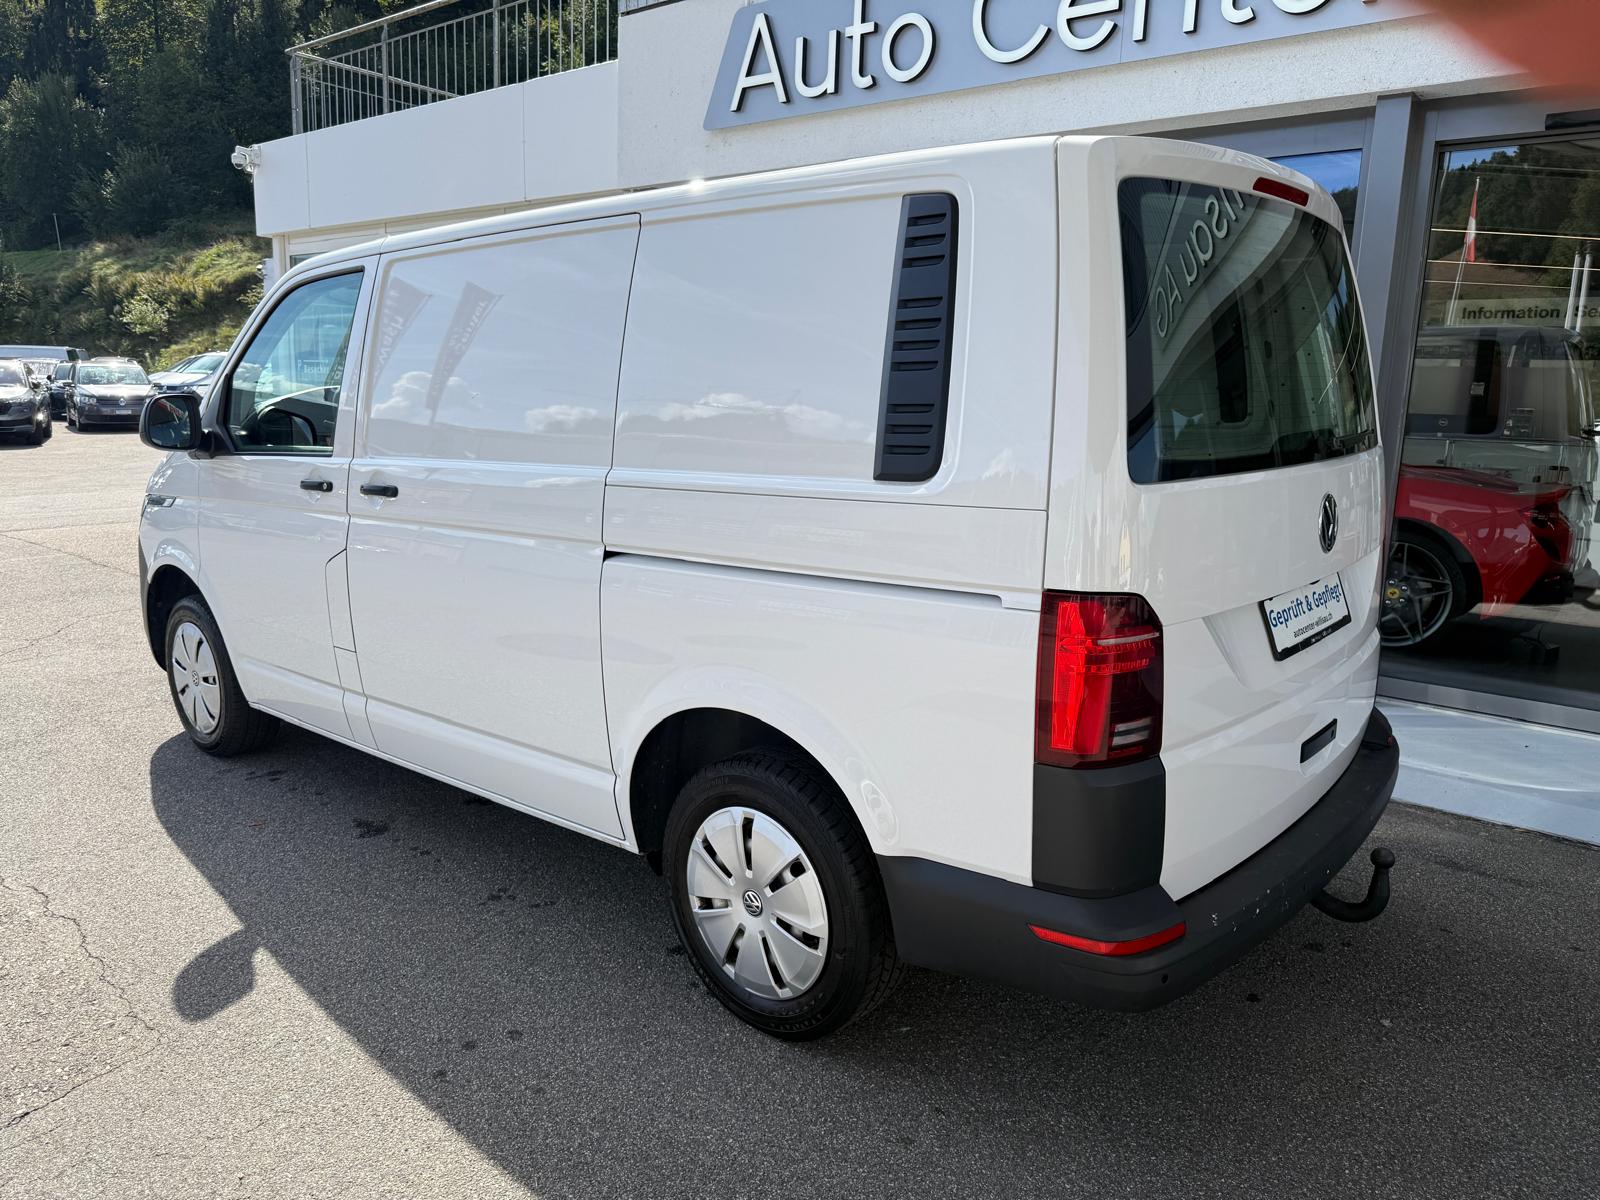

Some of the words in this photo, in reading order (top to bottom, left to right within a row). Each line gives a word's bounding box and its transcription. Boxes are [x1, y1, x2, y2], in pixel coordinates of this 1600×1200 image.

[730, 0, 936, 112] Auto
[1462, 305, 1560, 319] Information
[1269, 597, 1306, 628] Geprüft
[1305, 595, 1313, 612] &
[1313, 583, 1341, 610] Gepflegt
[1293, 613, 1333, 638] autocenter-willisau.ch
